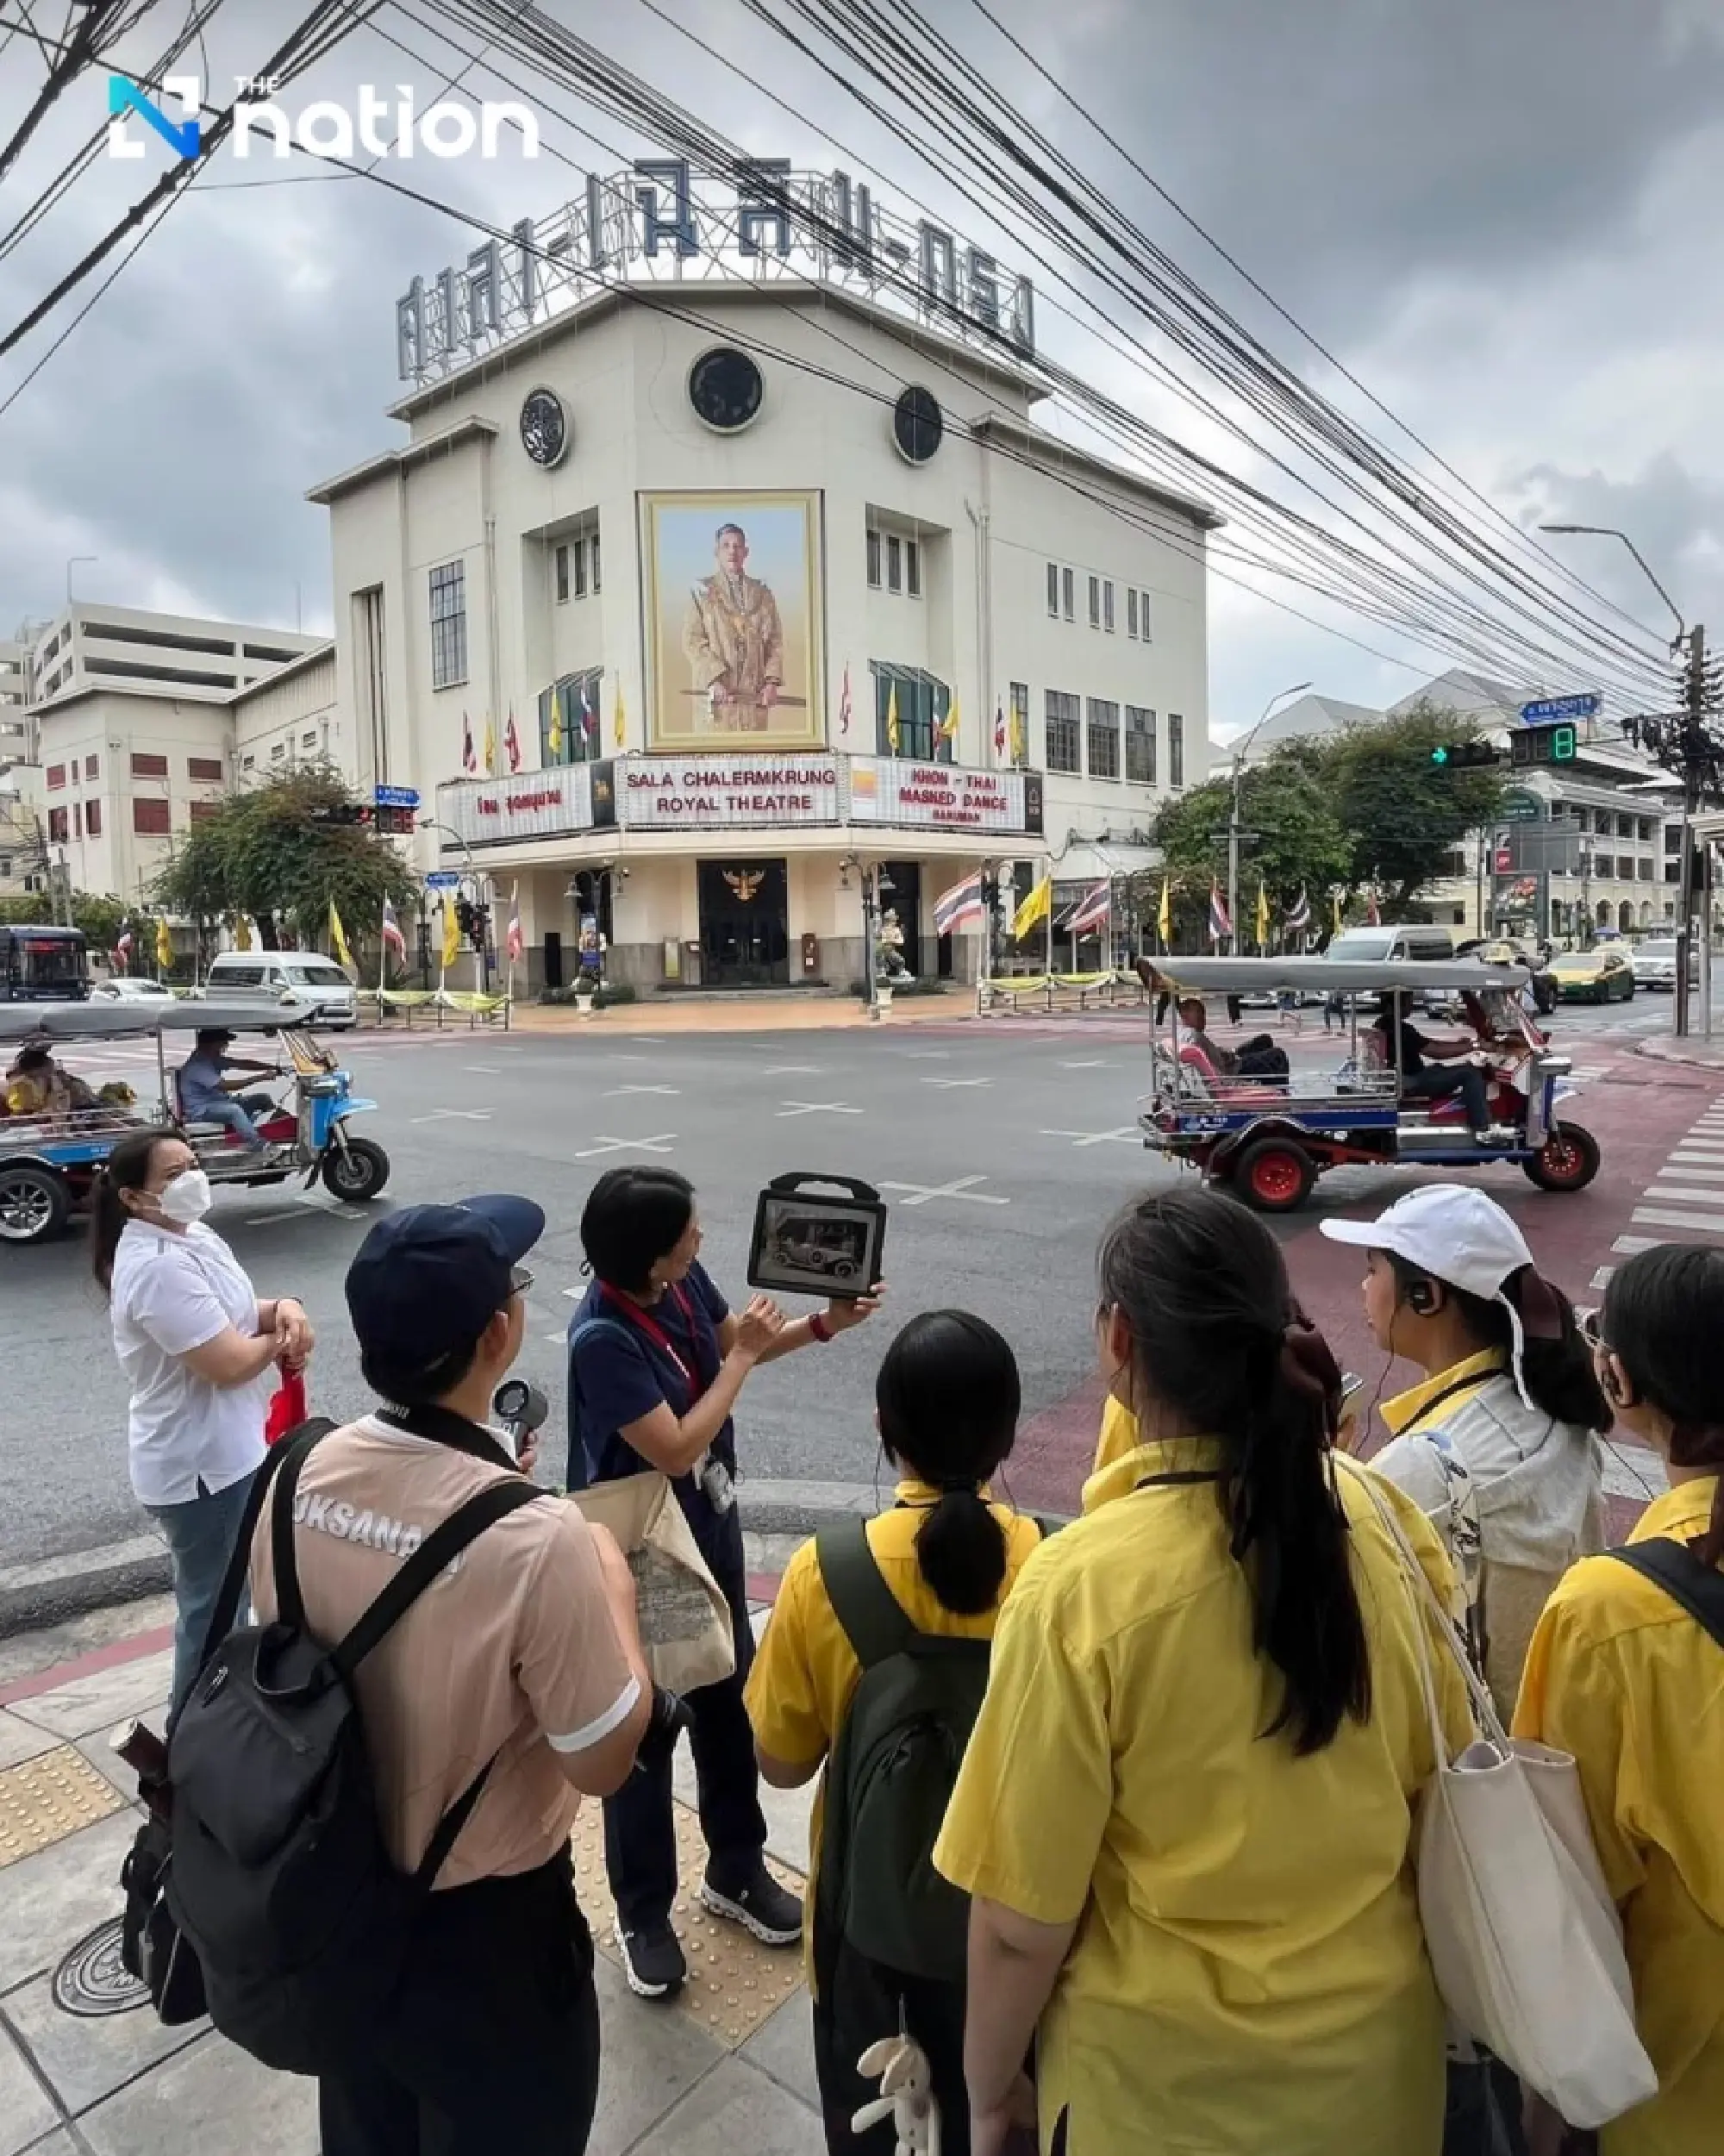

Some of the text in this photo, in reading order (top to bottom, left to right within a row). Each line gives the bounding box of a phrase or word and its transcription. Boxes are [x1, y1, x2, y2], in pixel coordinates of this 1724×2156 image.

[628, 769, 836, 788] SALA CHALERMKRUNG
[965, 775, 996, 791] THAI
[657, 795, 814, 814] ROYAL THEATRE
[899, 786, 957, 806] MASKED
[963, 793, 1007, 811] DANCE
